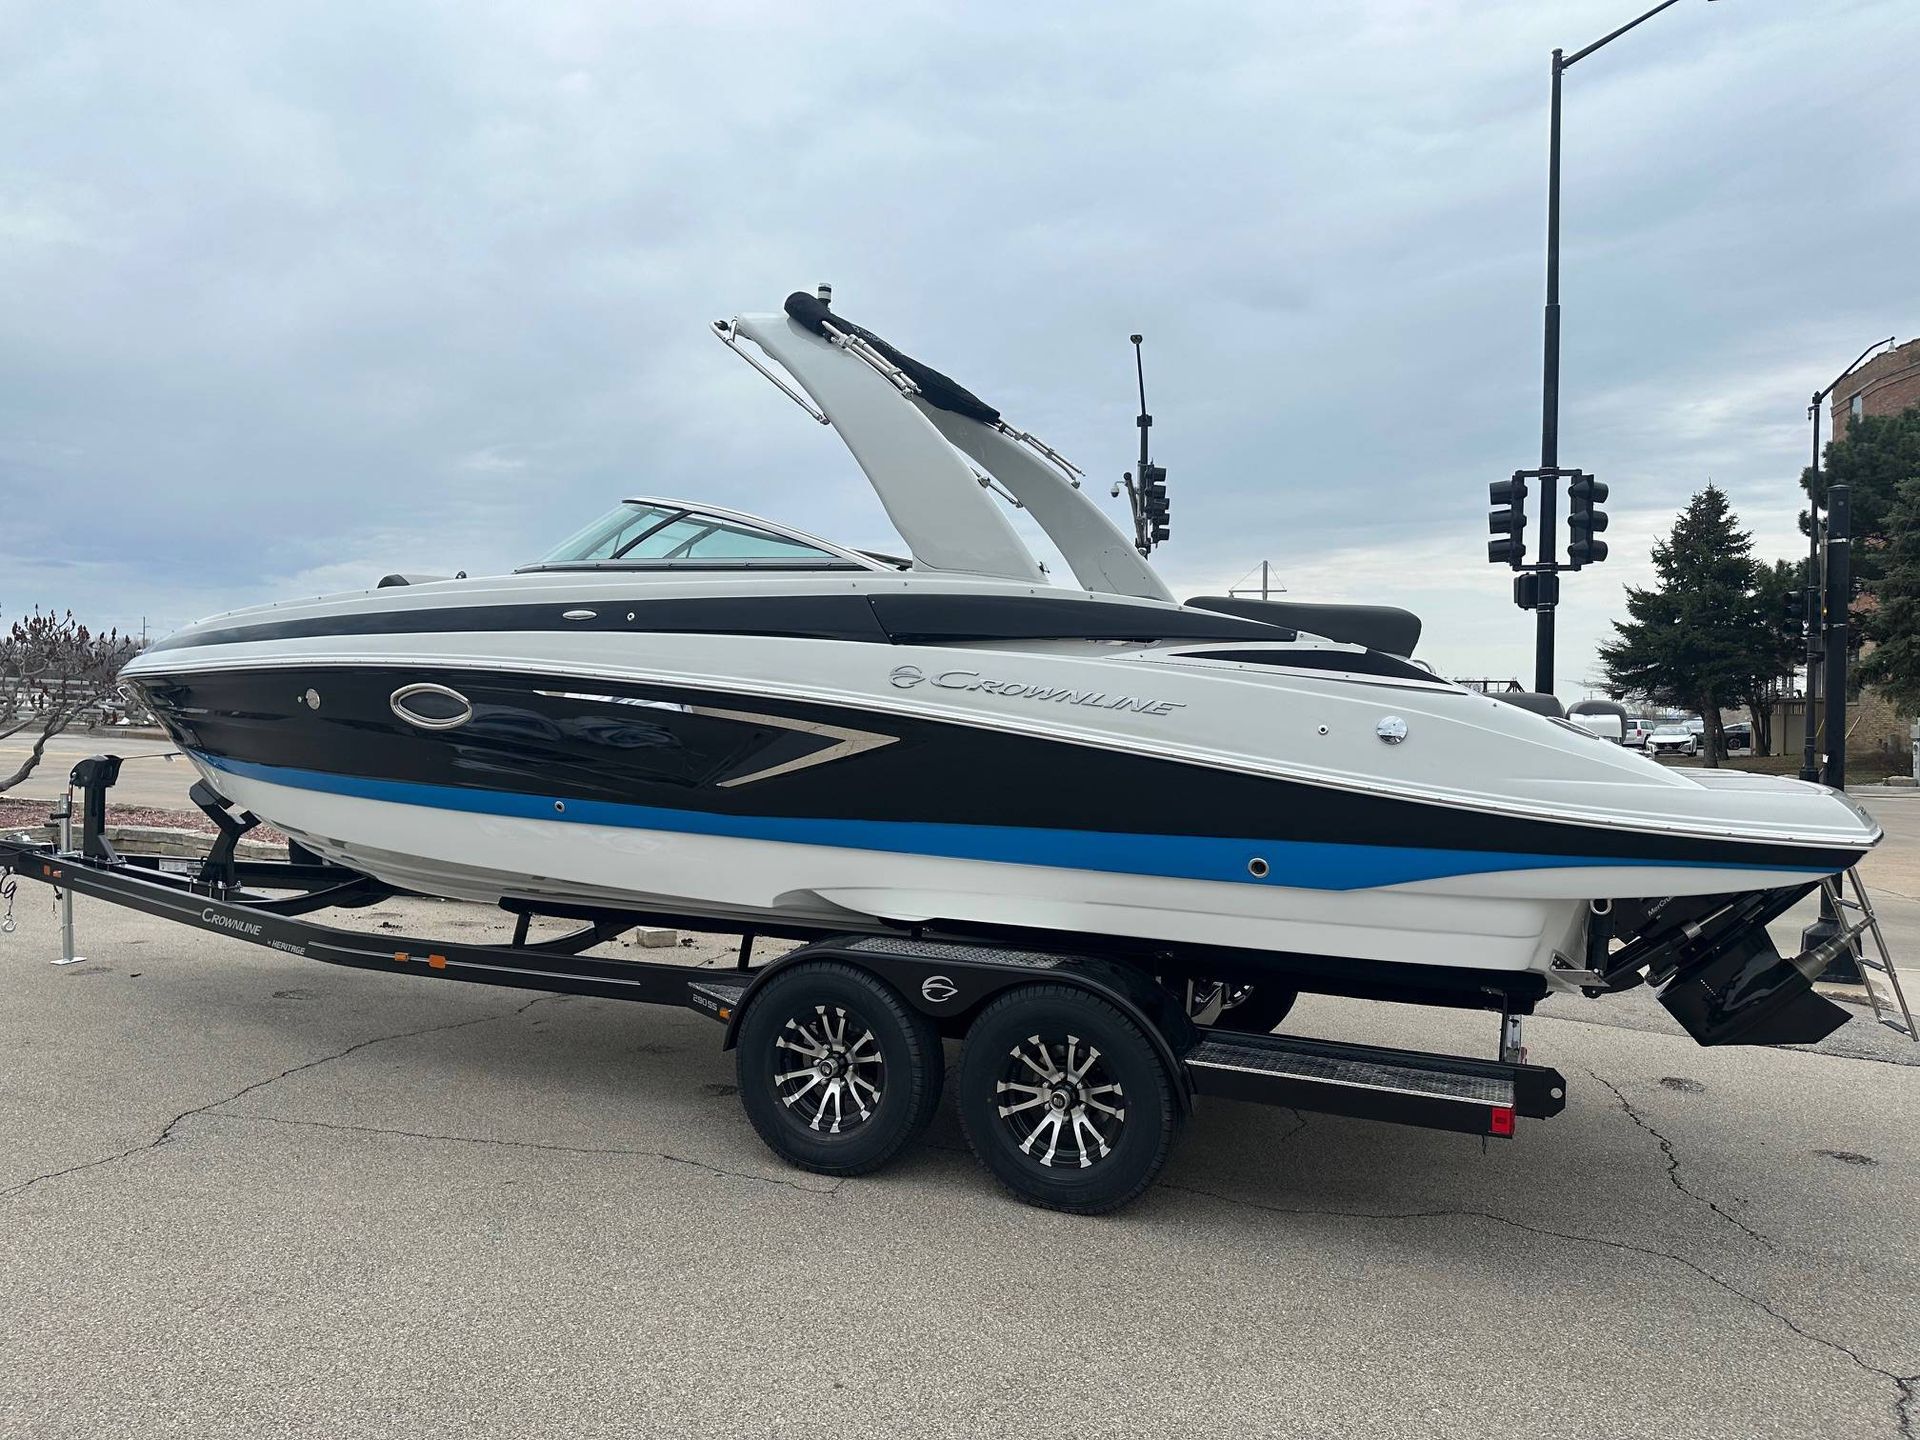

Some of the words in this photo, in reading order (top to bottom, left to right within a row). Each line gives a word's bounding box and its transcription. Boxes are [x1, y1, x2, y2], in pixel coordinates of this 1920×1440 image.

[930, 671, 1186, 715] CROWNLINE
[201, 907, 262, 936] CROWNLINE
[271, 939, 306, 955] HERITAGE
